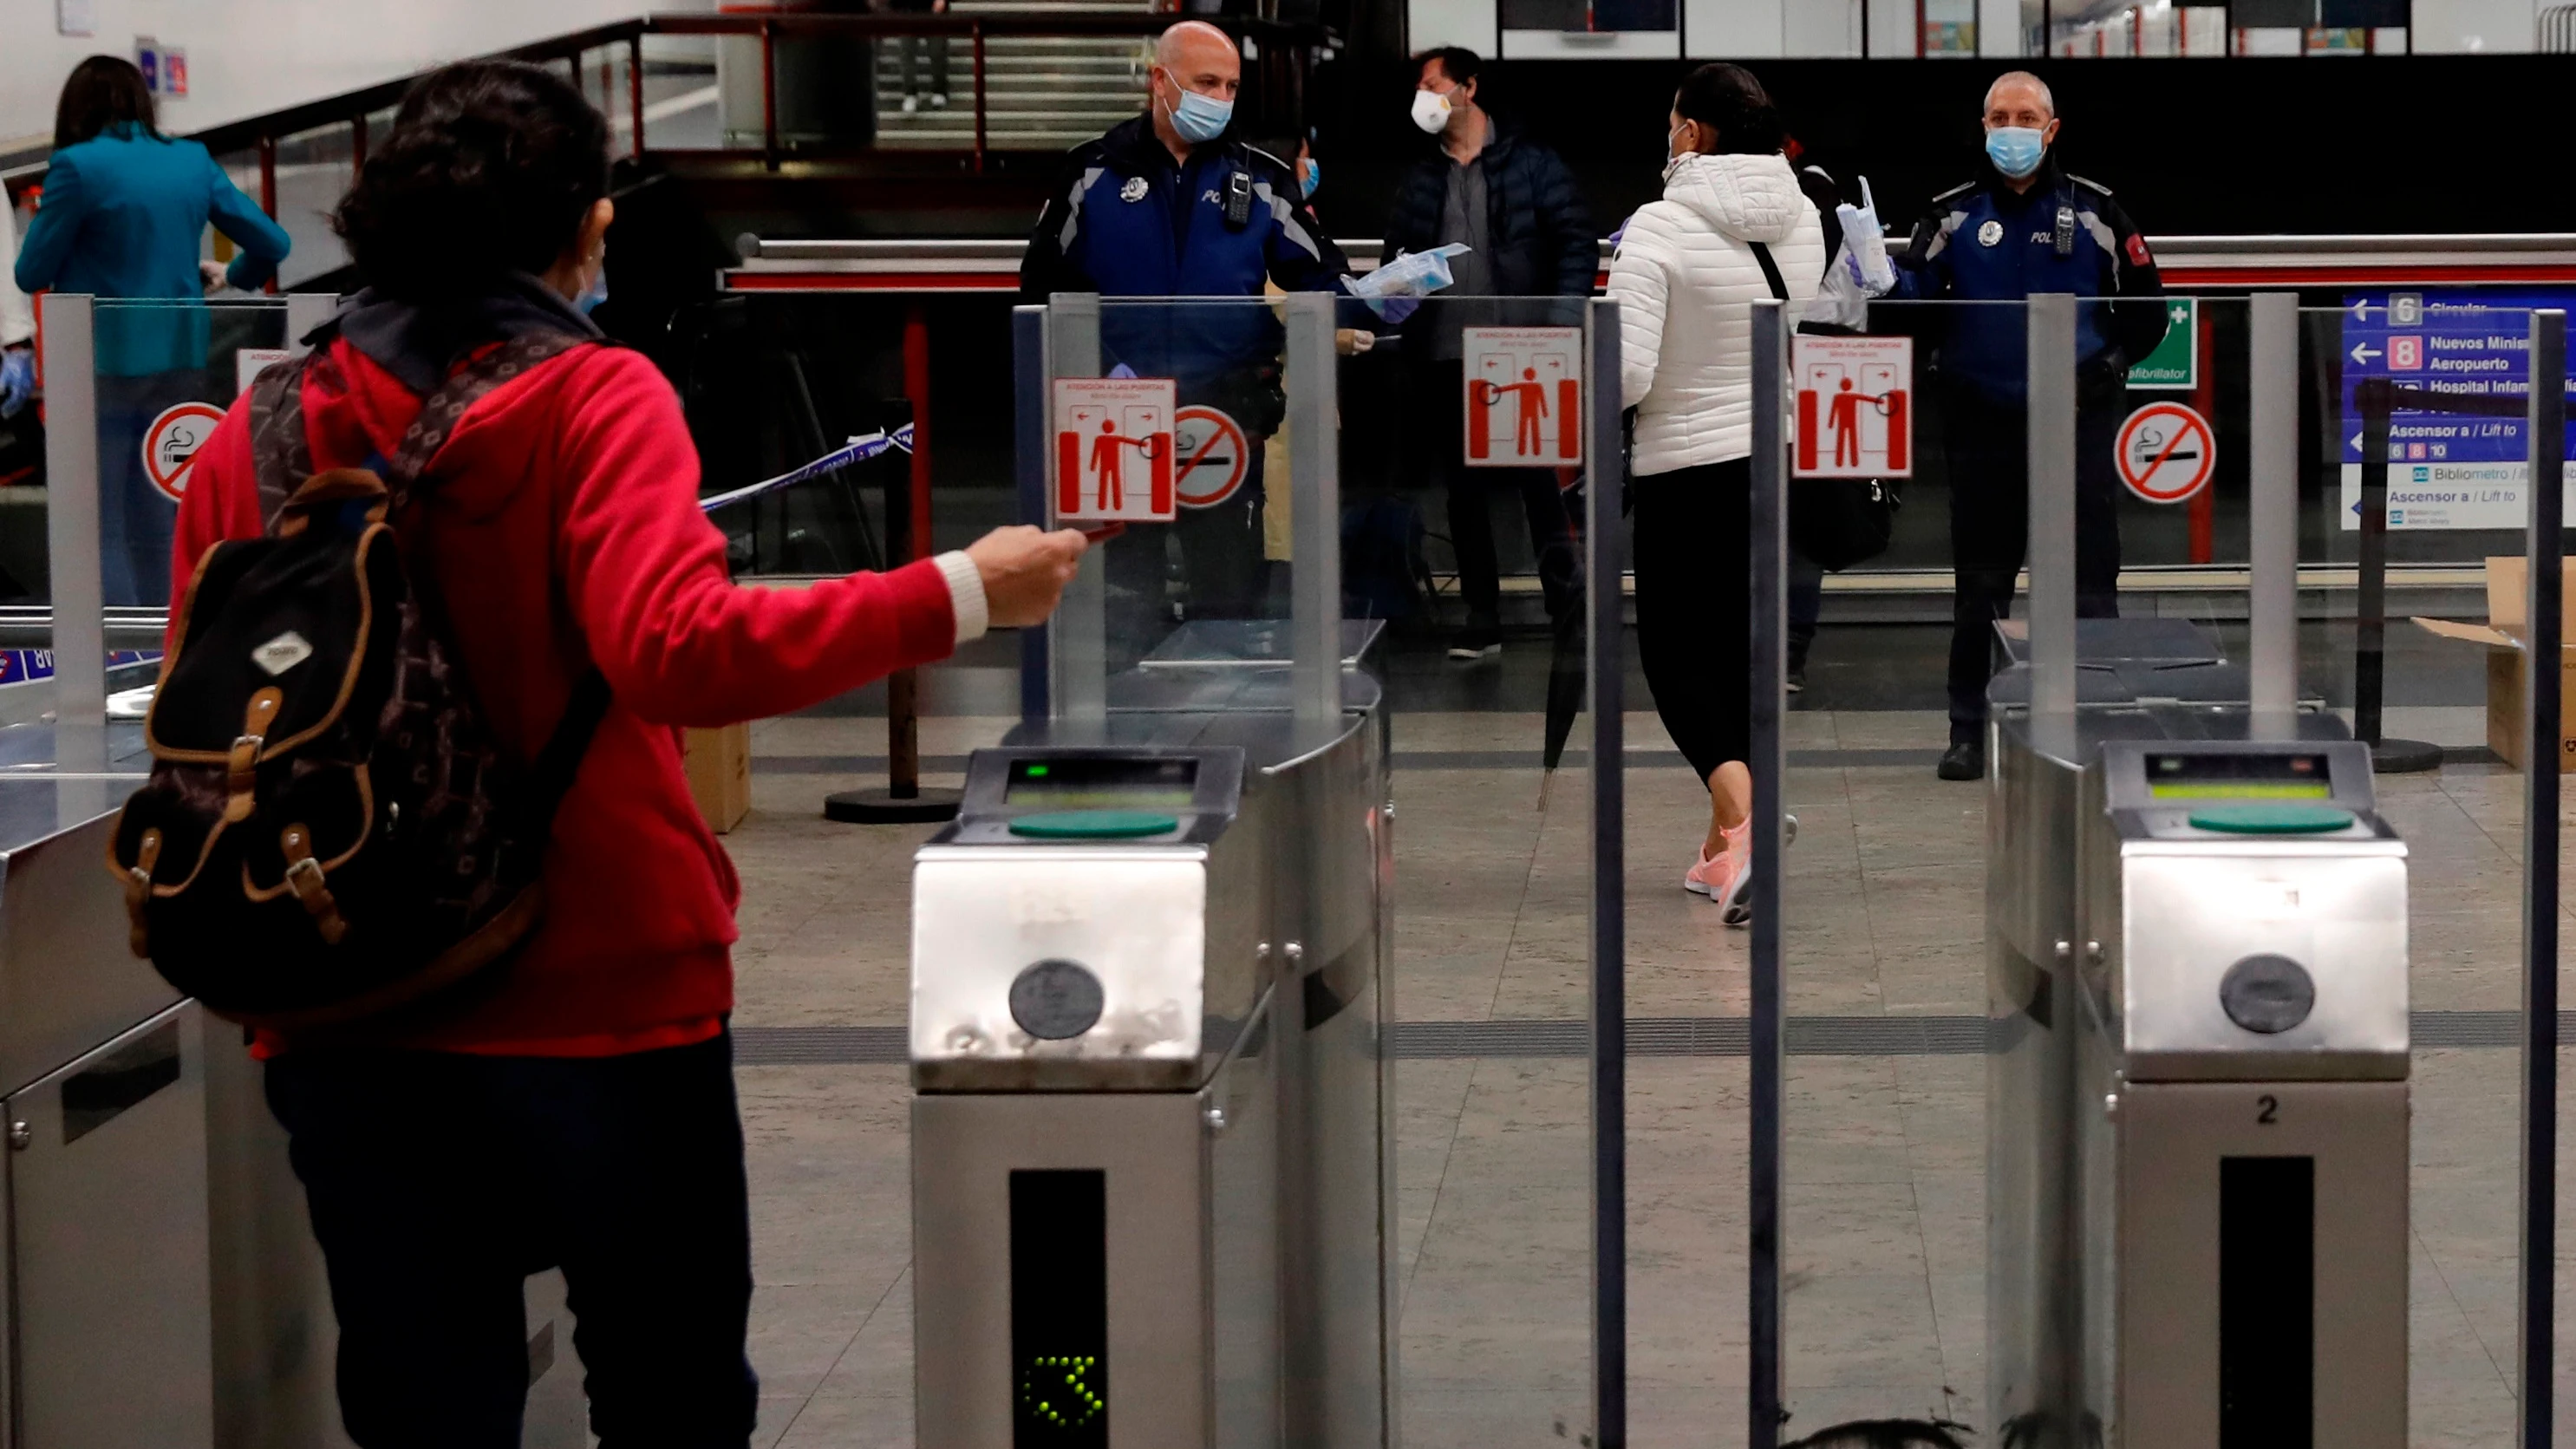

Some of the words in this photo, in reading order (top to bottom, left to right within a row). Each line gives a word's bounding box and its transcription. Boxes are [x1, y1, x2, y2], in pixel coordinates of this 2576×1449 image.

[2397, 297, 2415, 322] 6
[2430, 336, 2483, 349] Nuevos
[2397, 341, 2415, 366] 8
[2429, 357, 2509, 373] Aeropuerto
[2430, 380, 2488, 395] Hospital
[2389, 425, 2457, 438] Ascensor
[2461, 428, 2469, 437] a
[2481, 423, 2502, 437] Lift
[2504, 425, 2517, 437] to
[2392, 445, 2401, 457] 6
[2413, 445, 2422, 457] 8
[2431, 445, 2446, 457] 10
[2435, 468, 2508, 480] Bibliometro
[2389, 492, 2456, 503] Ascensor
[2461, 493, 2469, 502] a
[2481, 490, 2501, 503] Lift
[2503, 491, 2516, 502] to
[2257, 1094, 2278, 1125] 2
